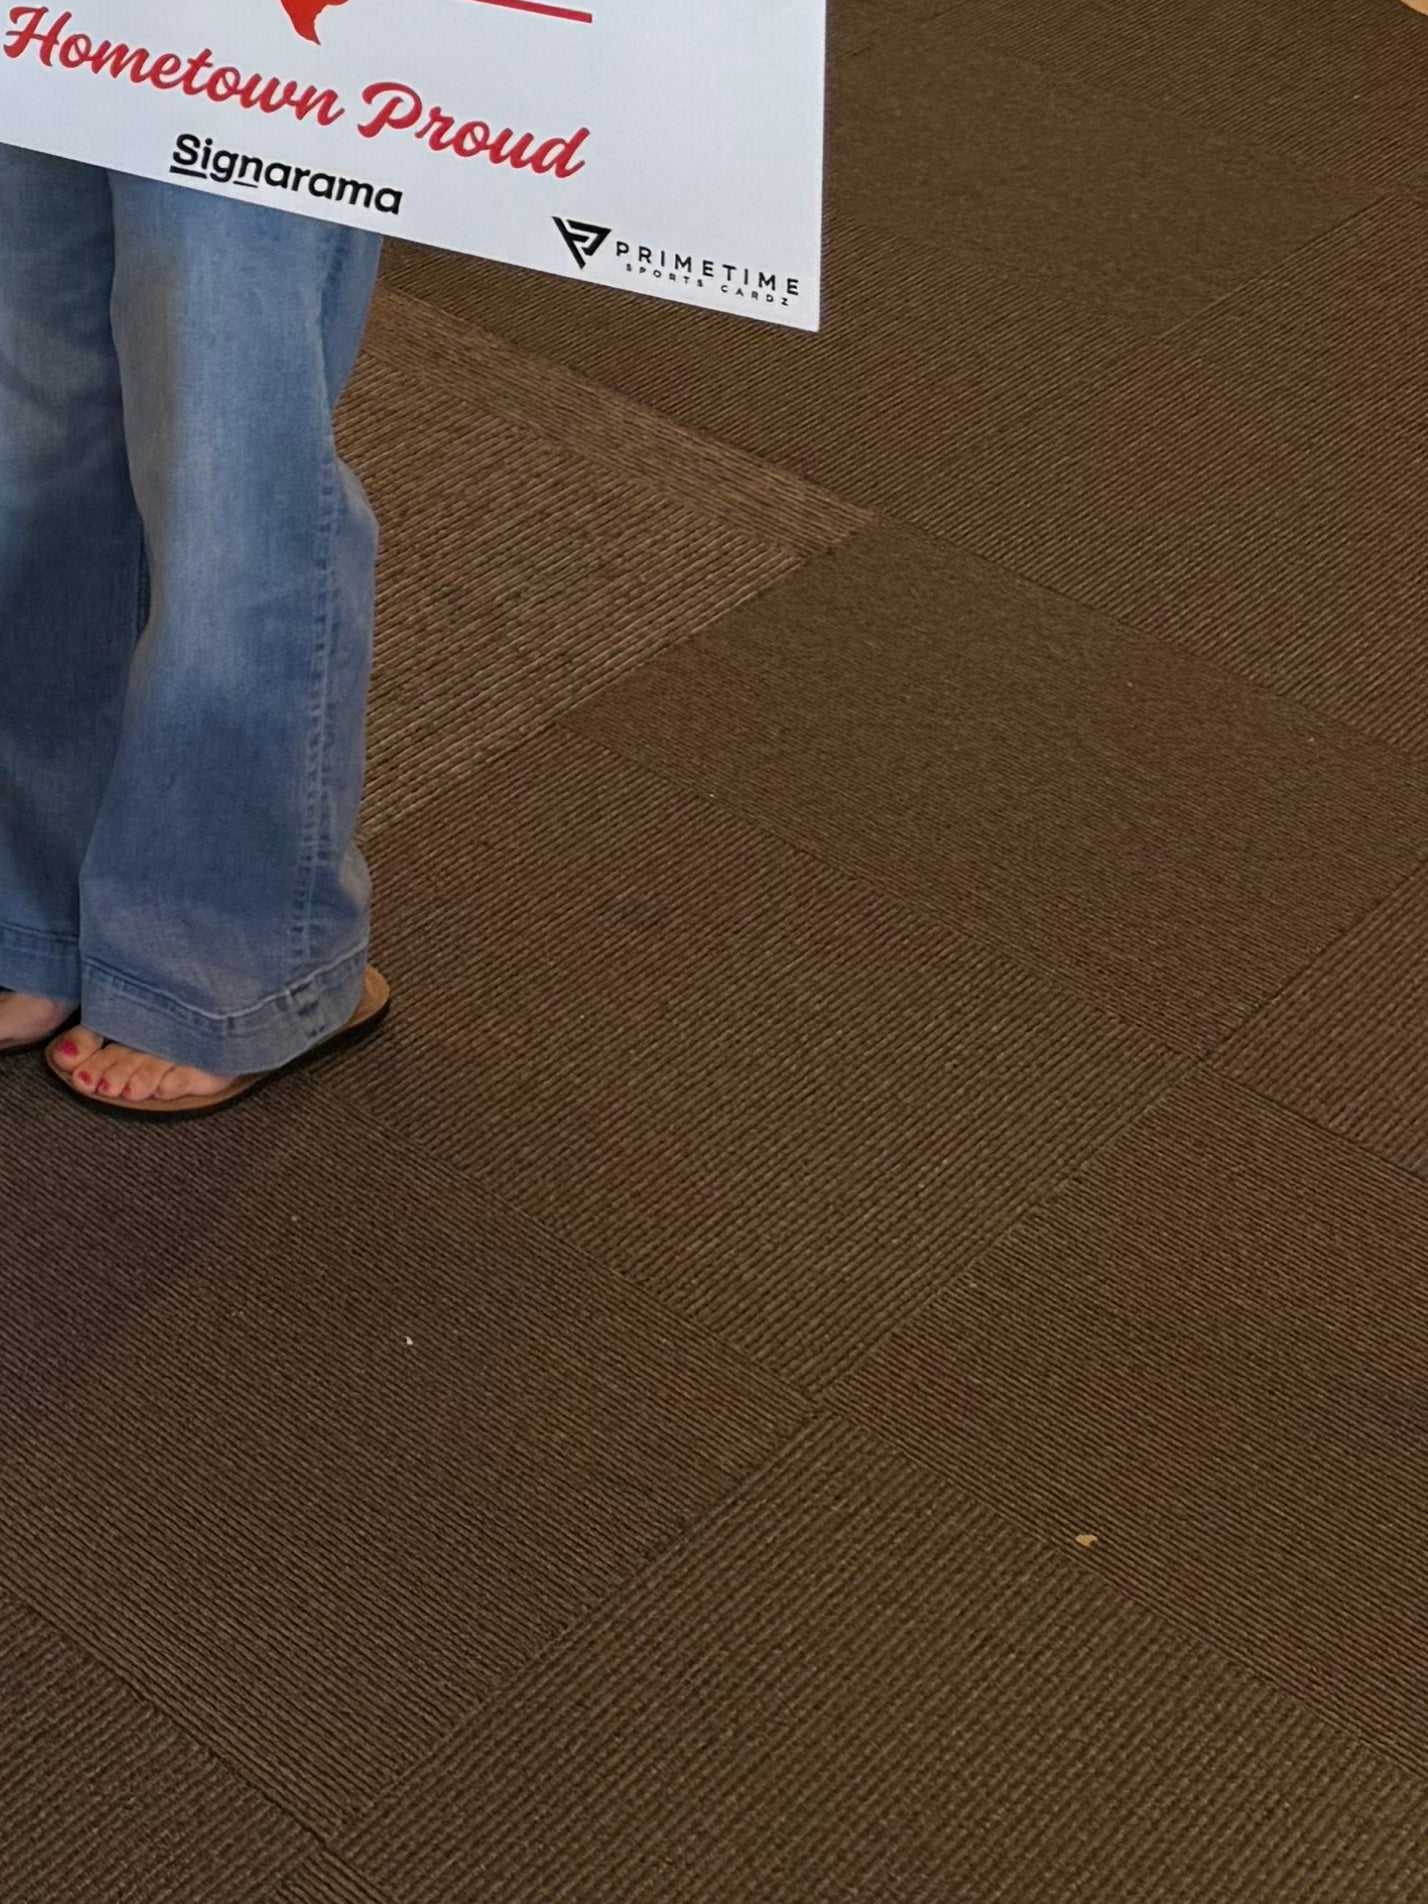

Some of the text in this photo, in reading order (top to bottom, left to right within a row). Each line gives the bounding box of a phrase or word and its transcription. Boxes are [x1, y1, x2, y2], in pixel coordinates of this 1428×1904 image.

[5, 7, 588, 178] Hometown Proud
[172, 134, 403, 215] Signarama
[616, 241, 799, 296] PRIMETIME
[626, 263, 789, 307] SPORTS CARDZ
